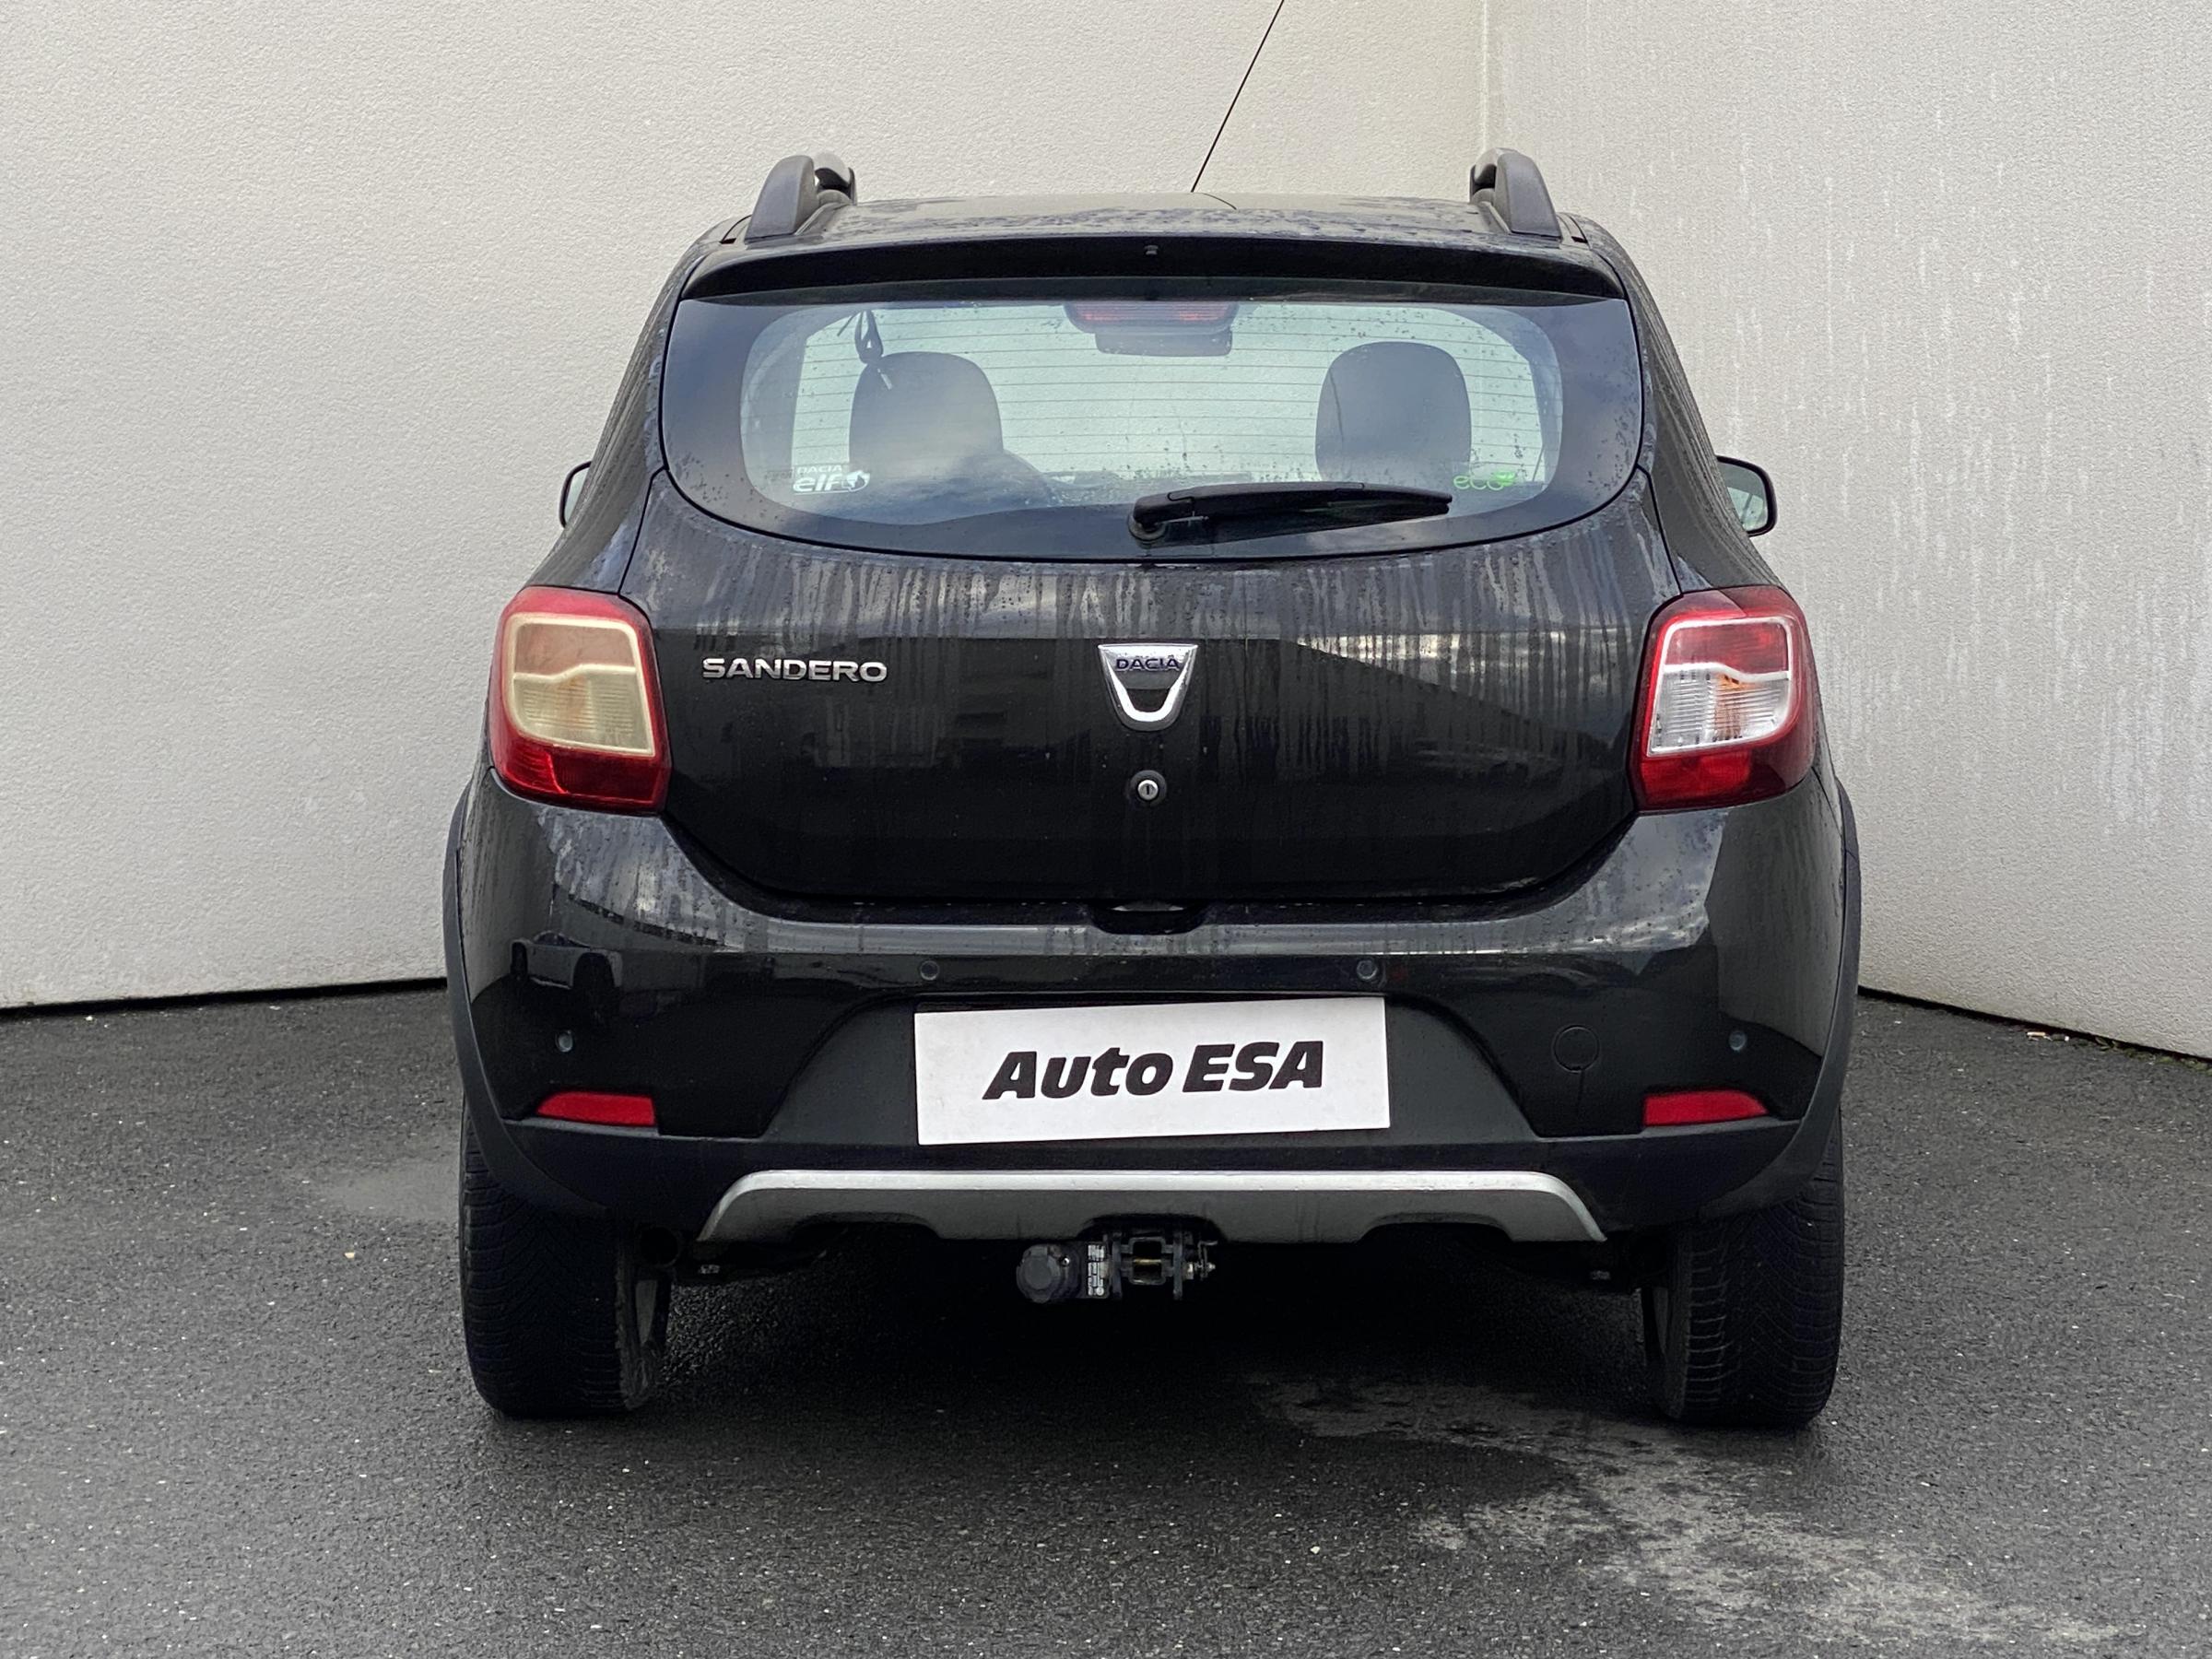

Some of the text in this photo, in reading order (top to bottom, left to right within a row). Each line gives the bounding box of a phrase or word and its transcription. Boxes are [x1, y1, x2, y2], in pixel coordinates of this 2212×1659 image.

[796, 465, 842, 474] DACIA
[793, 474, 842, 492] elf
[702, 657, 888, 683] SANDERO
[1116, 657, 1181, 672] DACIA
[982, 1041, 1324, 1100] Auto ESA
